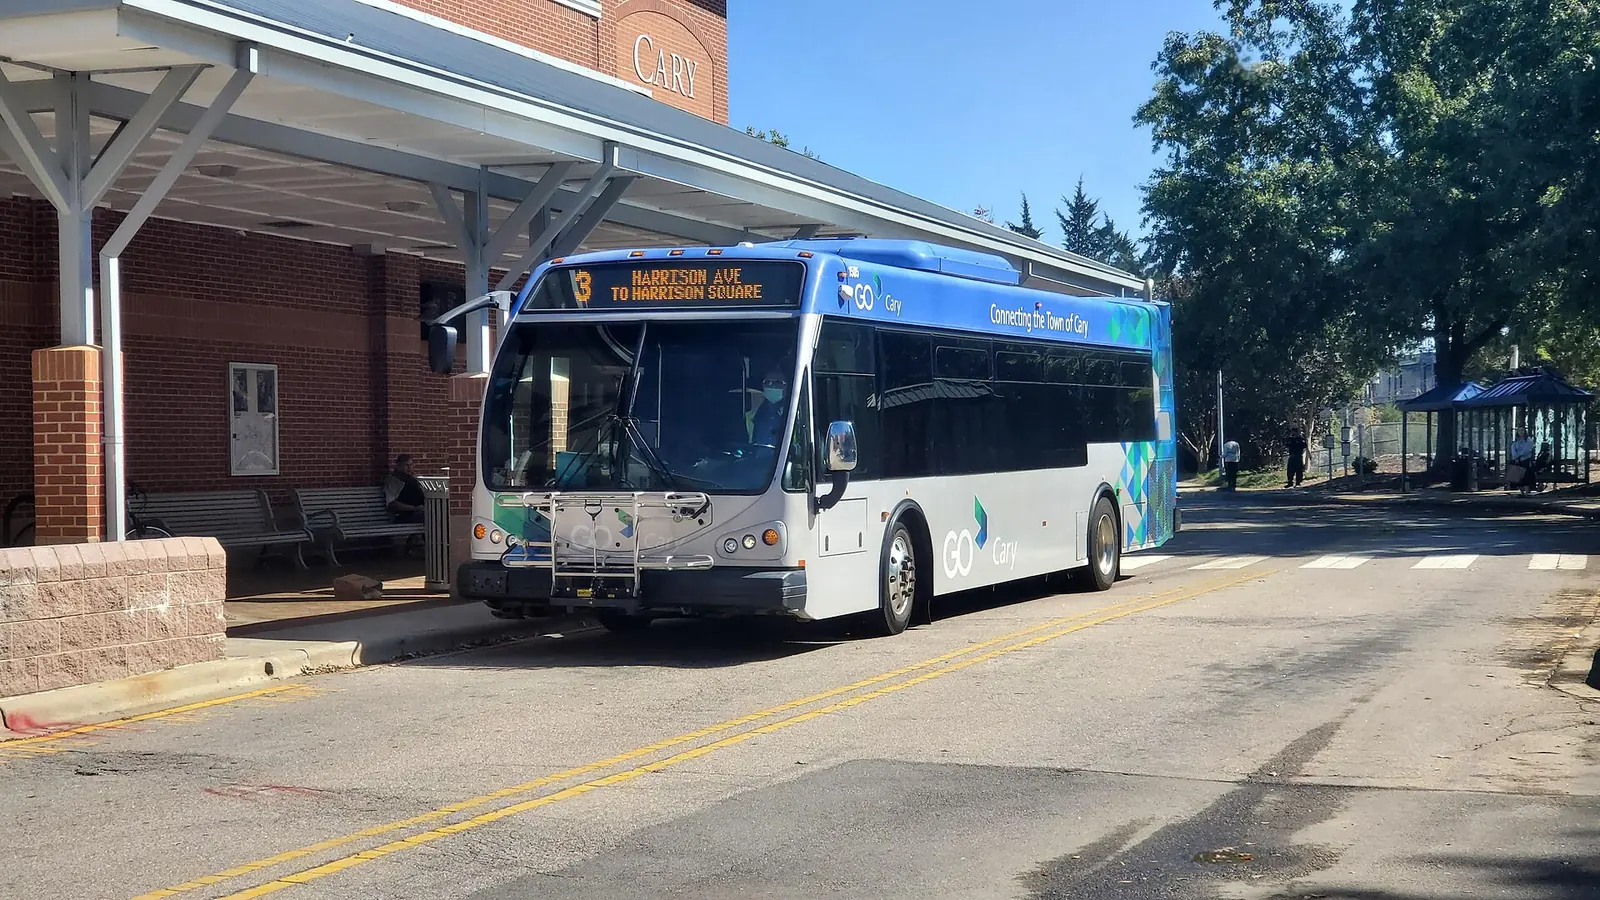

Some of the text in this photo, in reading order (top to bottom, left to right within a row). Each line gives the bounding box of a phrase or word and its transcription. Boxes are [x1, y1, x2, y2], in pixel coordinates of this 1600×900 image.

[633, 34, 697, 99] CARY
[575, 270, 592, 302] 3
[611, 285, 762, 301] TO HARRISON SQUARE
[632, 268, 742, 286] HARRISON AVE
[854, 283, 902, 316] GO Cary
[990, 303, 1089, 339] Connecting the Town of Cary
[943, 528, 1017, 579] GO Cary
